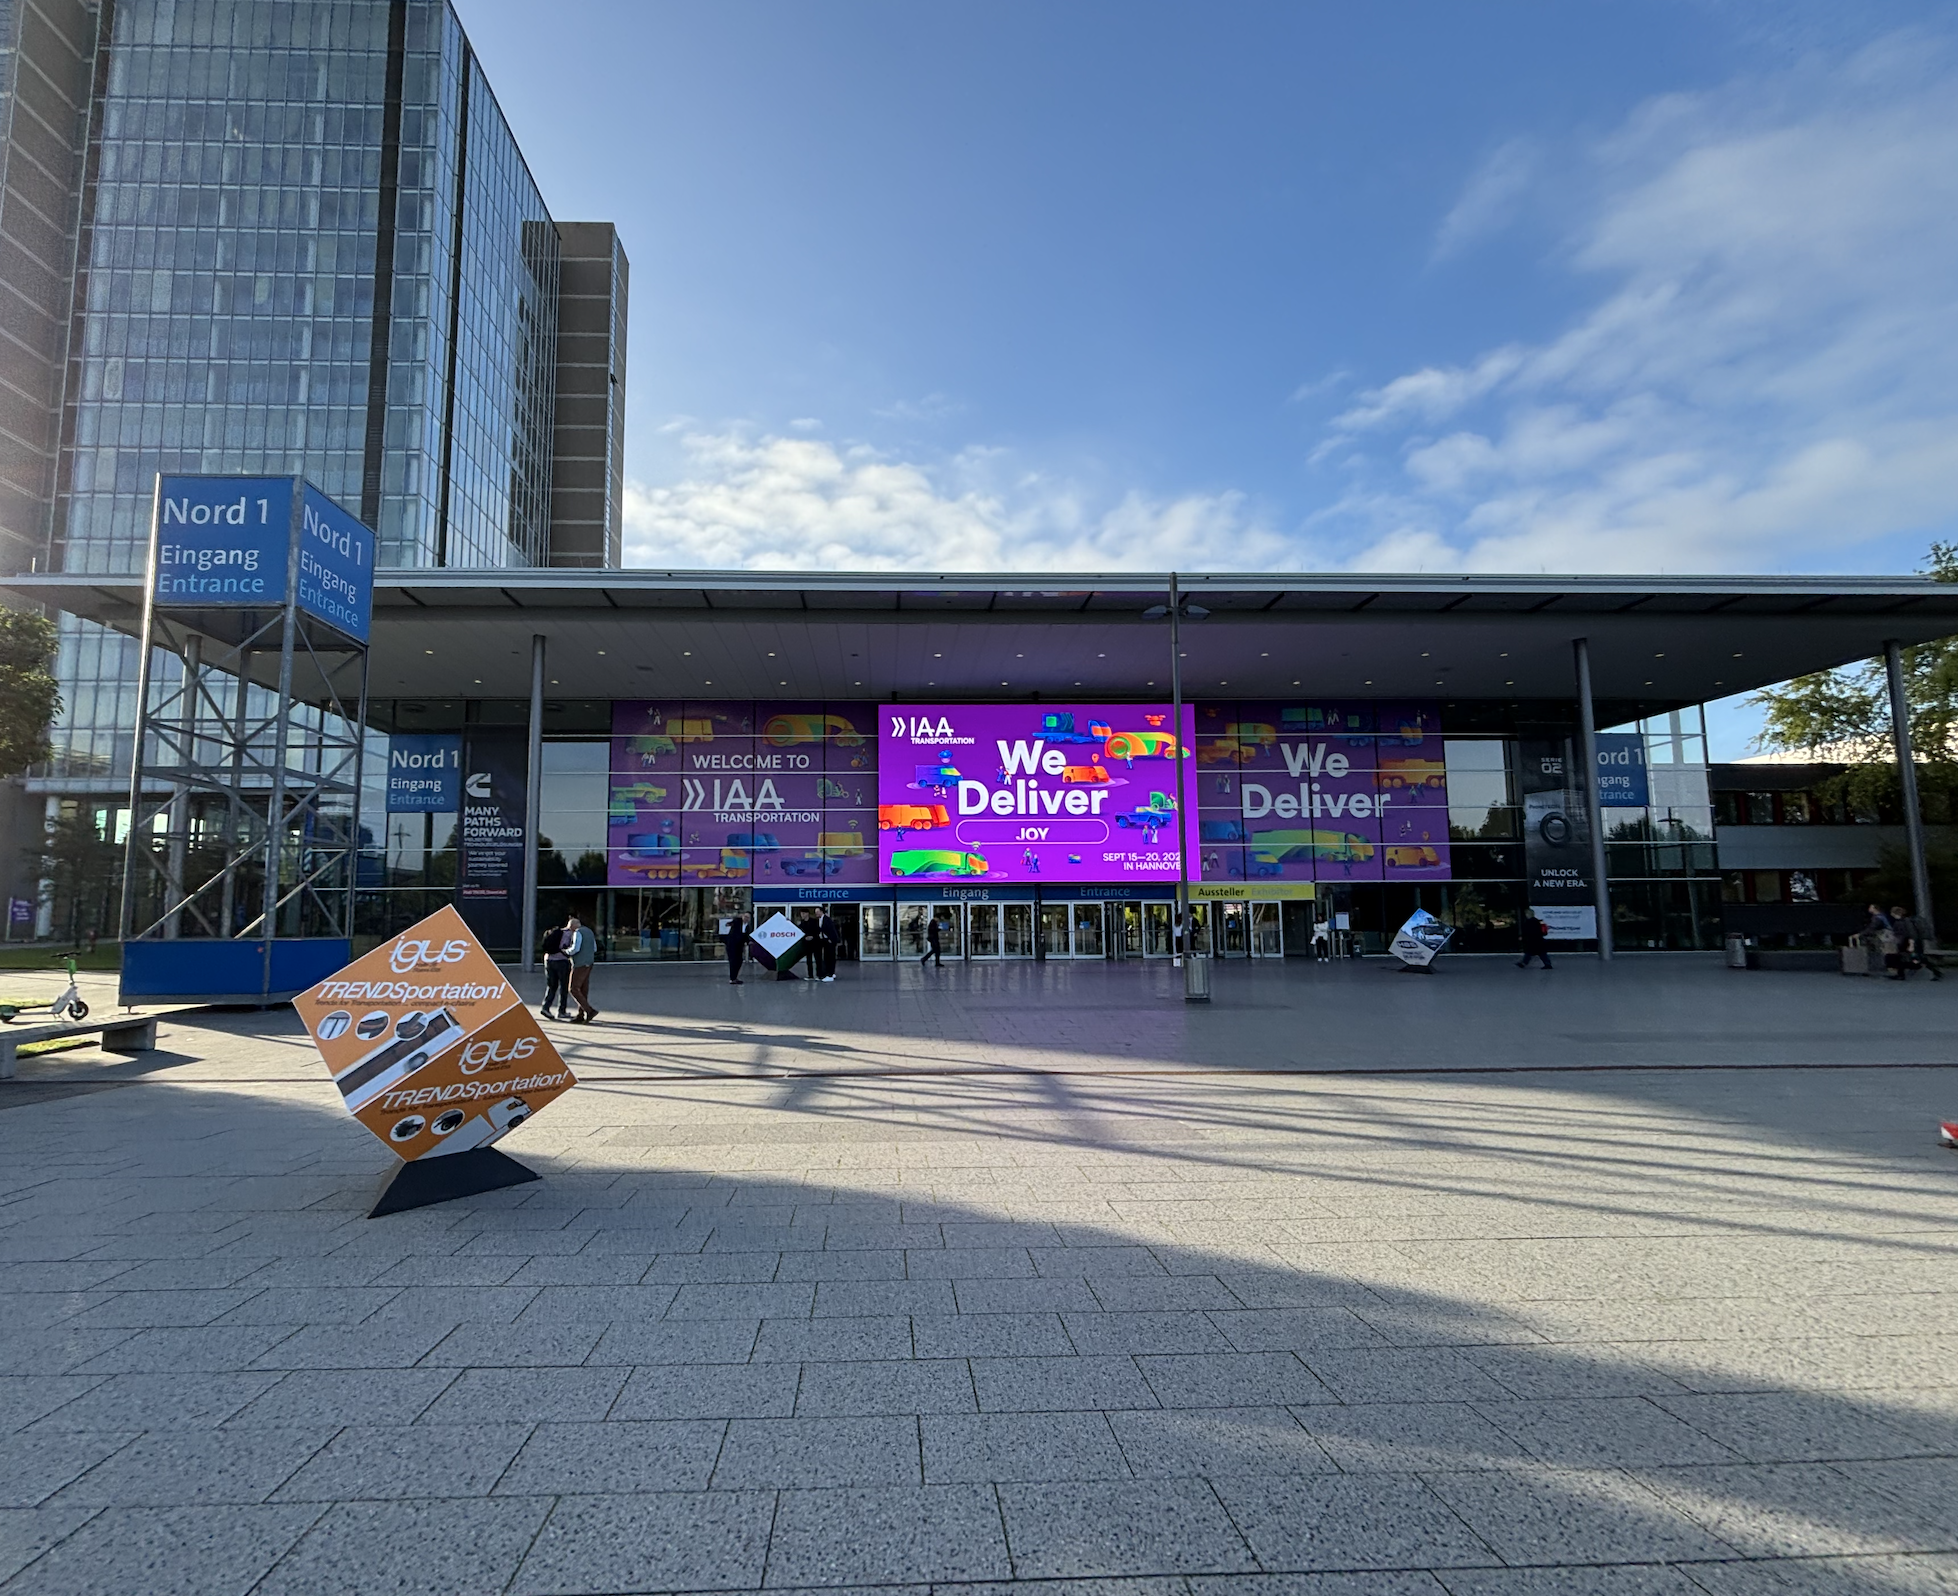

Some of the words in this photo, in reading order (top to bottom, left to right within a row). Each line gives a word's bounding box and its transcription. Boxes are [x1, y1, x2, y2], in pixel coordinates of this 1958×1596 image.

[163, 497, 246, 524] Nord
[256, 499, 268, 524] 1
[303, 504, 350, 558] Nord
[355, 541, 362, 566] 1
[160, 545, 259, 571] Eingang
[158, 574, 265, 593] Entrance
[300, 550, 356, 604] Eingang
[299, 579, 358, 628] Entrance
[910, 717, 954, 737] IAA
[910, 737, 975, 745] TRANSPORTATION
[391, 749, 444, 768] Nord
[451, 750, 459, 768] 1
[692, 754, 782, 769] WELCOME
[786, 754, 810, 769] TO
[997, 739, 1067, 776] We
[1280, 742, 1350, 778] We
[1597, 746, 1629, 765] ord
[1634, 748, 1642, 765] 1
[1541, 763, 1563, 774] 02
[390, 778, 442, 792] Eingang
[390, 794, 445, 805] Entrance
[713, 779, 785, 810] IAA
[958, 779, 1108, 815] Deliver
[1241, 783, 1391, 819] Deliver
[1599, 789, 1635, 800] trance
[464, 807, 499, 816] MANY
[714, 813, 820, 823] TRANSPORTATION
[464, 817, 501, 826] PATHS
[464, 828, 523, 837] FORWARD
[1015, 827, 1049, 841] JOY
[1103, 852, 1126, 861] SEPT
[1162, 852, 1180, 862] 202
[1123, 862, 1133, 870] IN
[1136, 862, 1181, 870] HANNOVE
[1541, 869, 1579, 877] UNLOCK
[1198, 886, 1244, 897] Aussteller
[1251, 886, 1293, 897] Exhibitor
[1534, 880, 1541, 888] A
[1542, 880, 1564, 888] NEW
[1566, 880, 1588, 888] ERA.
[798, 888, 849, 899] Entrance
[942, 887, 989, 900] Eingang
[1080, 886, 1131, 898] Entrance
[389, 935, 469, 974] igus
[316, 981, 506, 1003] TRENDSportation!
[457, 1037, 540, 1075] igus
[382, 1070, 569, 1109] TRENDSportation!
